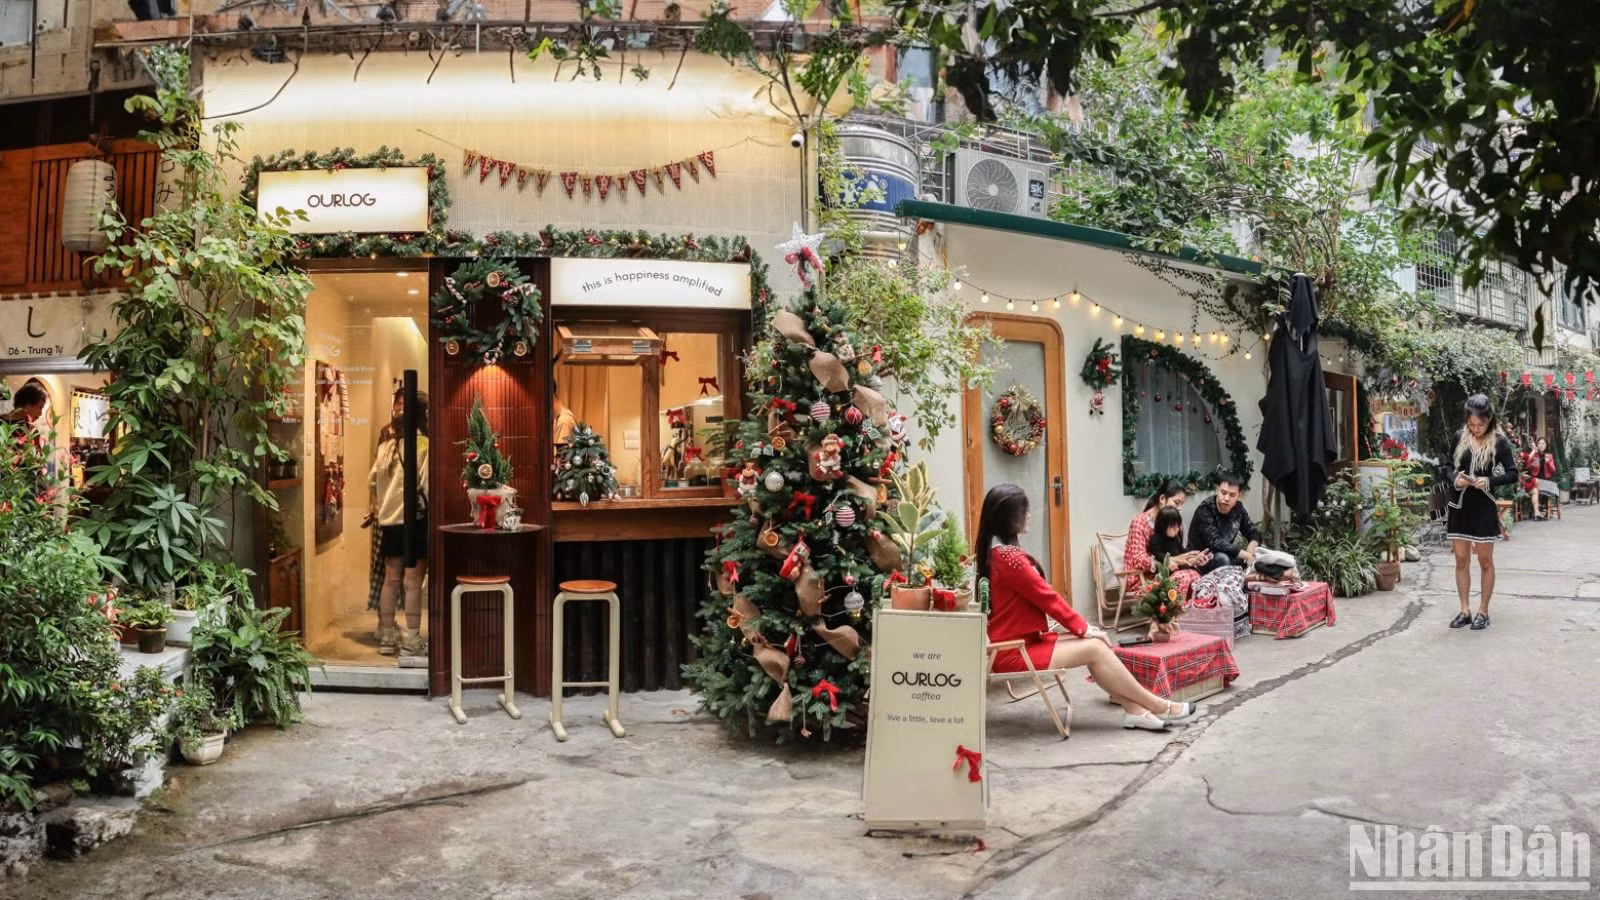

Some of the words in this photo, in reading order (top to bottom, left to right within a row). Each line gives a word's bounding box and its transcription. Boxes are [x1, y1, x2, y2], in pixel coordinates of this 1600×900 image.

[464, 153, 546, 188] MERRY
[564, 152, 714, 192] CHRISTMAS
[307, 193, 376, 208] OURLOG
[582, 280, 602, 293] this
[604, 276, 613, 285] is
[614, 270, 670, 283] happiness
[672, 273, 723, 297] amplified
[8, 347, 20, 356] D6
[28, 346, 53, 356] Trung
[912, 652, 926, 660] we
[927, 652, 942, 660] are
[892, 671, 962, 688] OURLOG
[911, 691, 941, 702] cofftea
[887, 713, 901, 722] live
[908, 714, 928, 724] little,
[929, 715, 946, 724] love
[953, 716, 964, 724] lot
